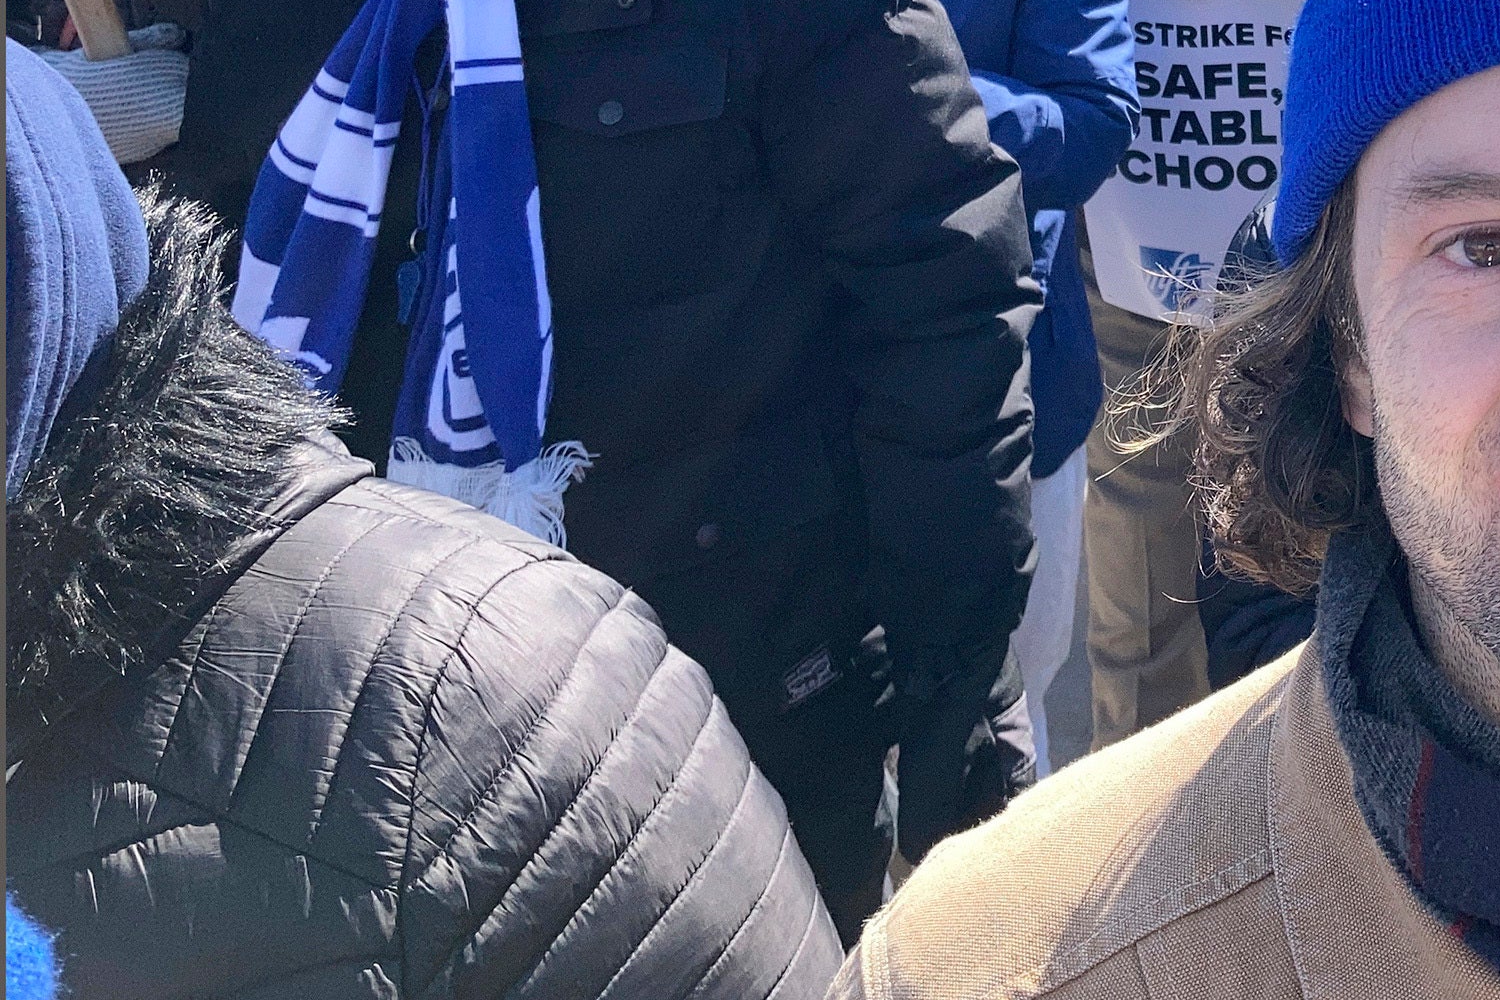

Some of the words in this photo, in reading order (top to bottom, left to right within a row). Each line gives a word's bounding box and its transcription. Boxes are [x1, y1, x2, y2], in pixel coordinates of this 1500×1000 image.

[1136, 22, 1254, 47] STRIKE
[1136, 63, 1283, 105] SAFE,
[1137, 108, 1284, 147] TABL
[1112, 150, 1277, 192] CHOO
